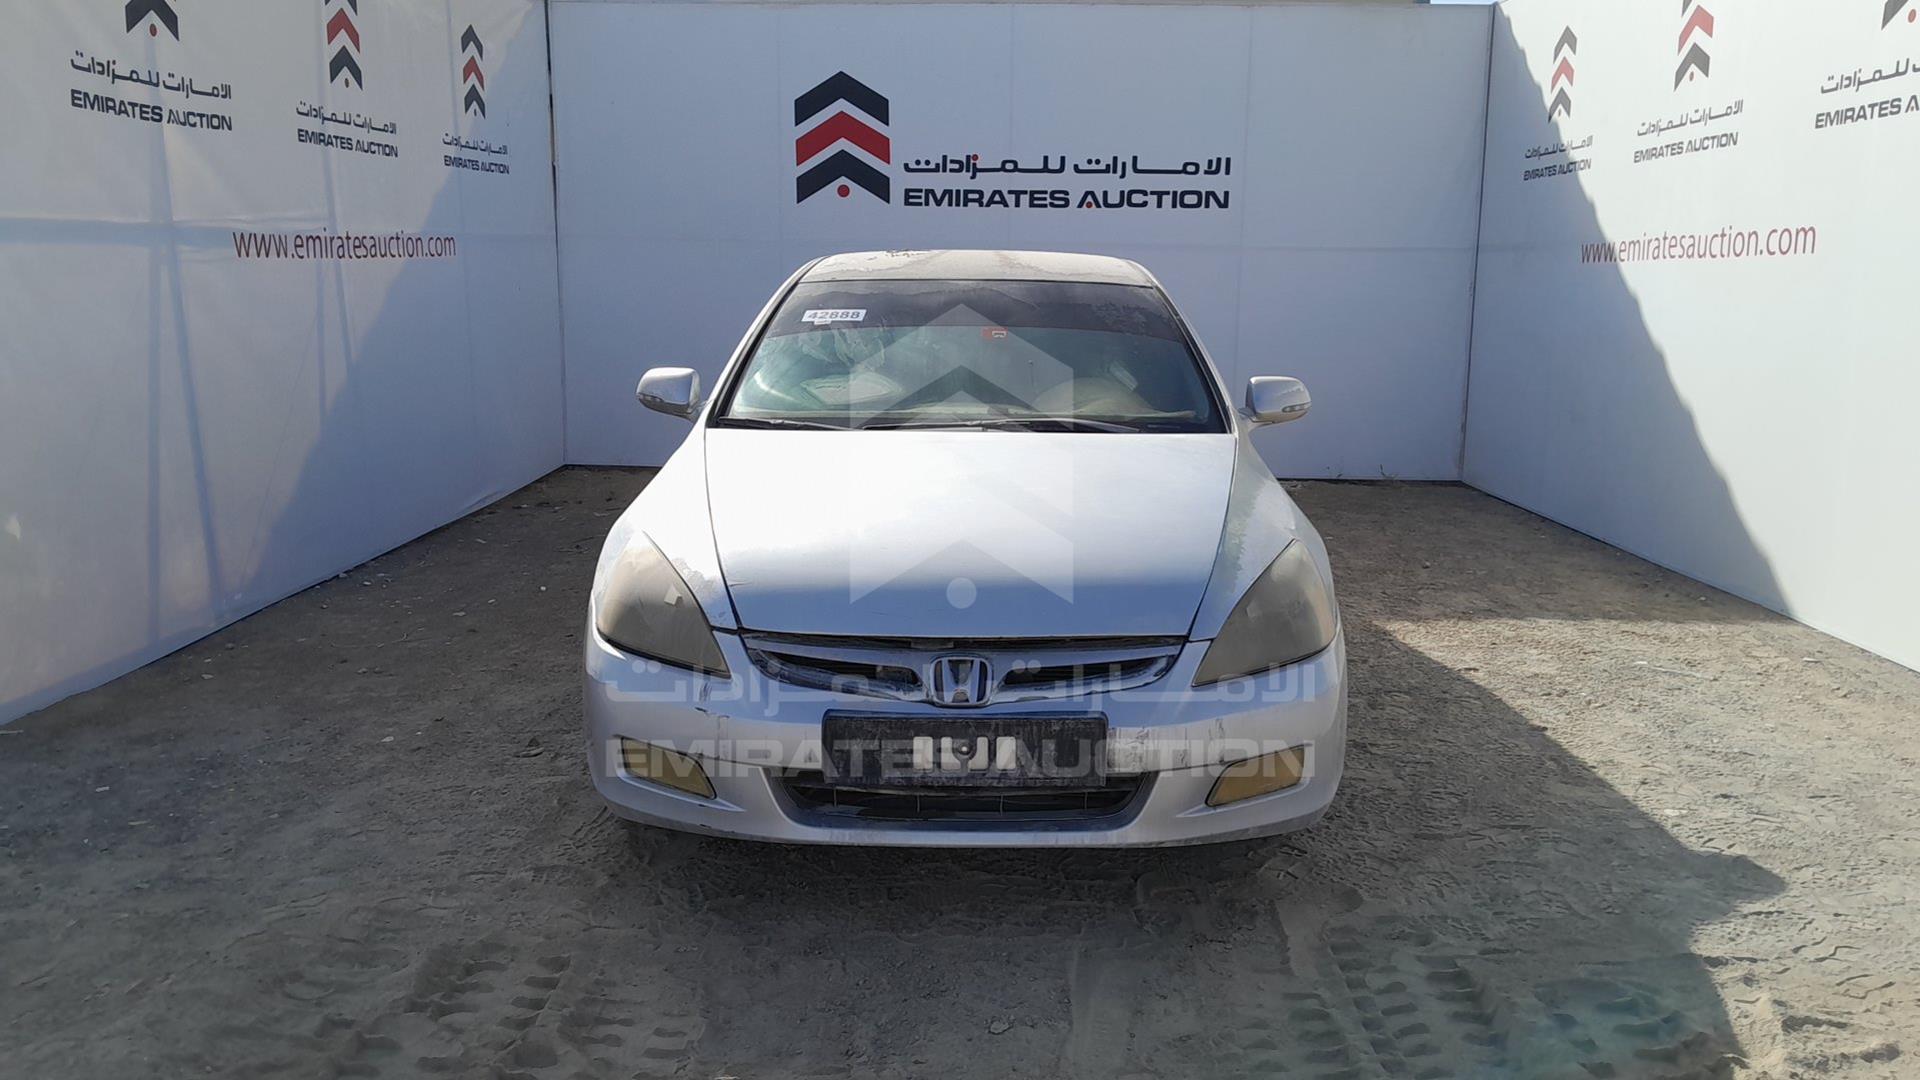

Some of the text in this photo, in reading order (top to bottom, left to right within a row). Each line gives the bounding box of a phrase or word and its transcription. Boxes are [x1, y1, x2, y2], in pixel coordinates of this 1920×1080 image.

[70, 50, 160, 88] للمزادات
[70, 89, 233, 131] EMIRATES AUCTION
[1815, 97, 1902, 129] EMIRATES
[297, 128, 398, 158] EMIRATES AUCTION
[1633, 132, 1739, 163] EMIRATES AUCTION
[443, 155, 509, 174] EMIRATES AUCTION
[903, 153, 1231, 179] الامارات للمزادات
[1523, 158, 1592, 181] EMIRATES AUCTION
[903, 188, 1229, 209] EMIRATES AUCTION
[233, 228, 456, 260] www.emiratesauction.com
[1581, 225, 1816, 264] www.emiratesauction.com
[807, 311, 861, 320] 42888
